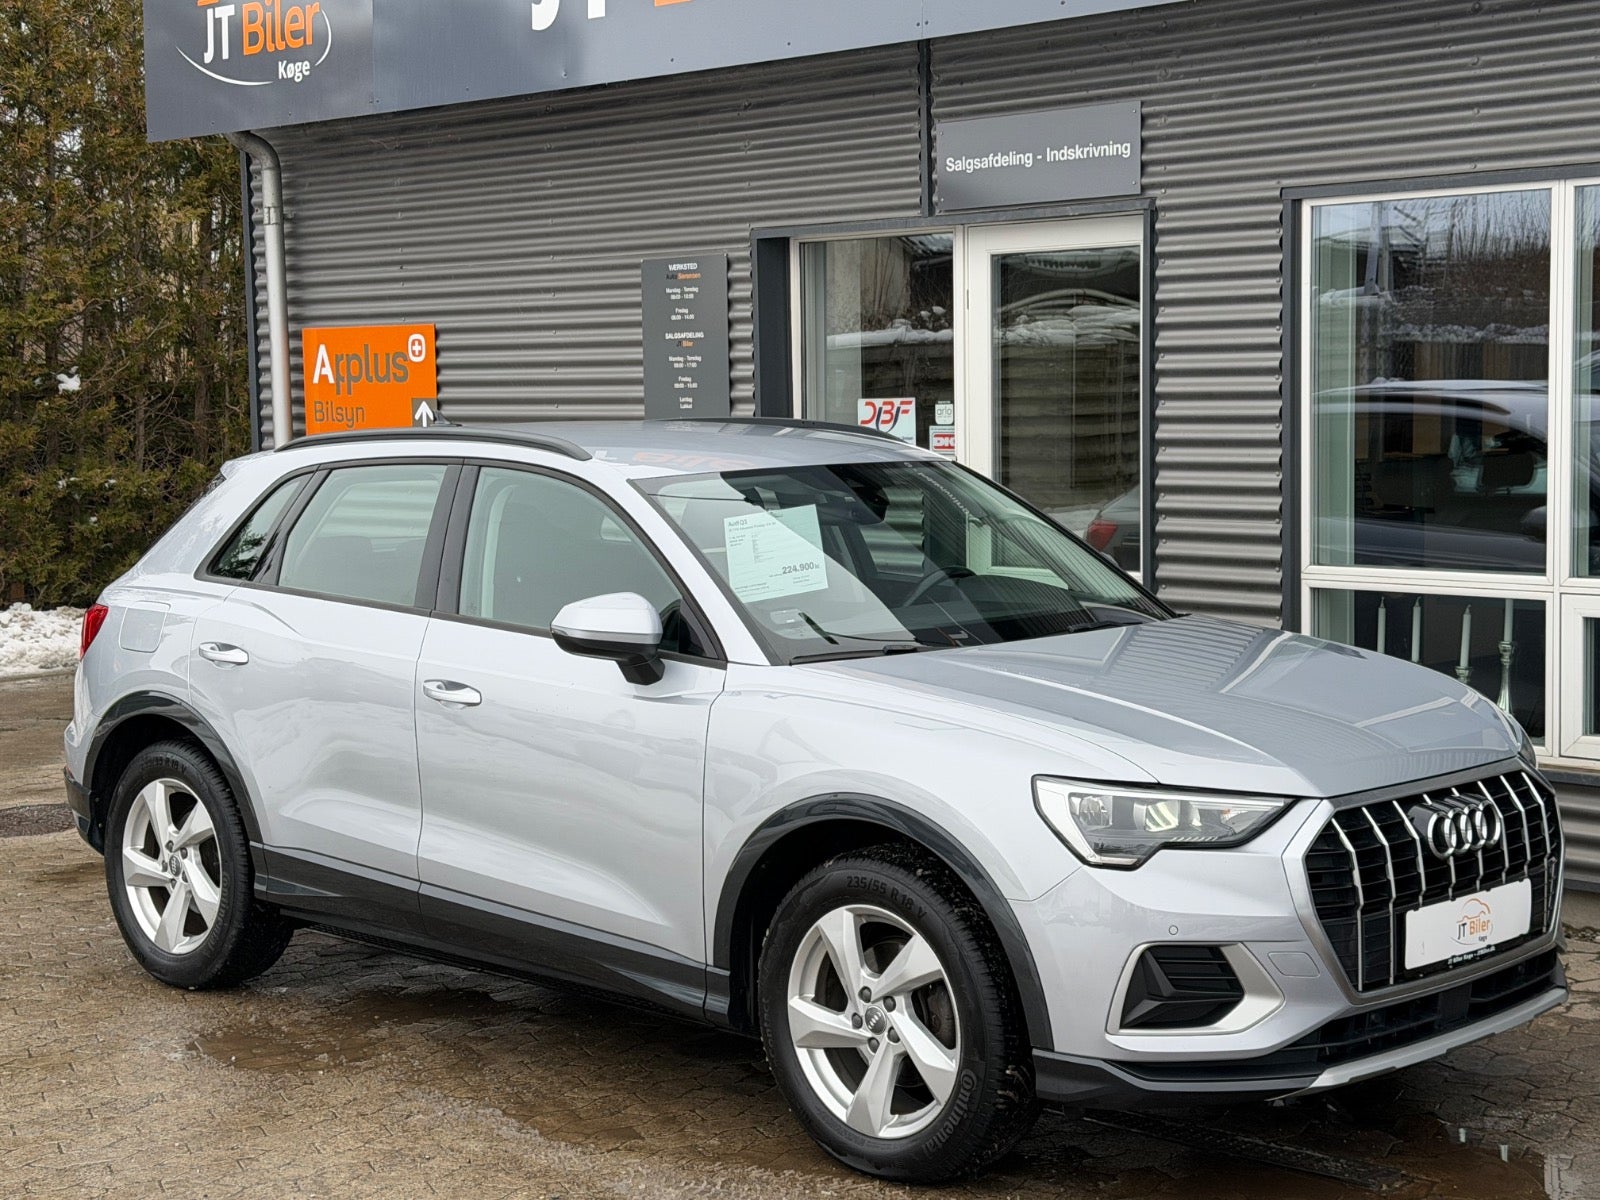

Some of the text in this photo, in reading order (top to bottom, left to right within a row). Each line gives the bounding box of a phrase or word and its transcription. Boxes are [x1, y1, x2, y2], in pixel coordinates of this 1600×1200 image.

[204, 0, 319, 63] JT Biler
[278, 60, 310, 82] Køge
[946, 151, 1033, 173] Salgsafdeling
[1046, 141, 1131, 162] Indskrivning
[314, 401, 365, 428] Bilsyn
[782, 562, 814, 574] 224.900
[846, 875, 888, 895] 235/55
[1458, 918, 1490, 940] JT Biler
[921, 1068, 977, 1153] Continental
